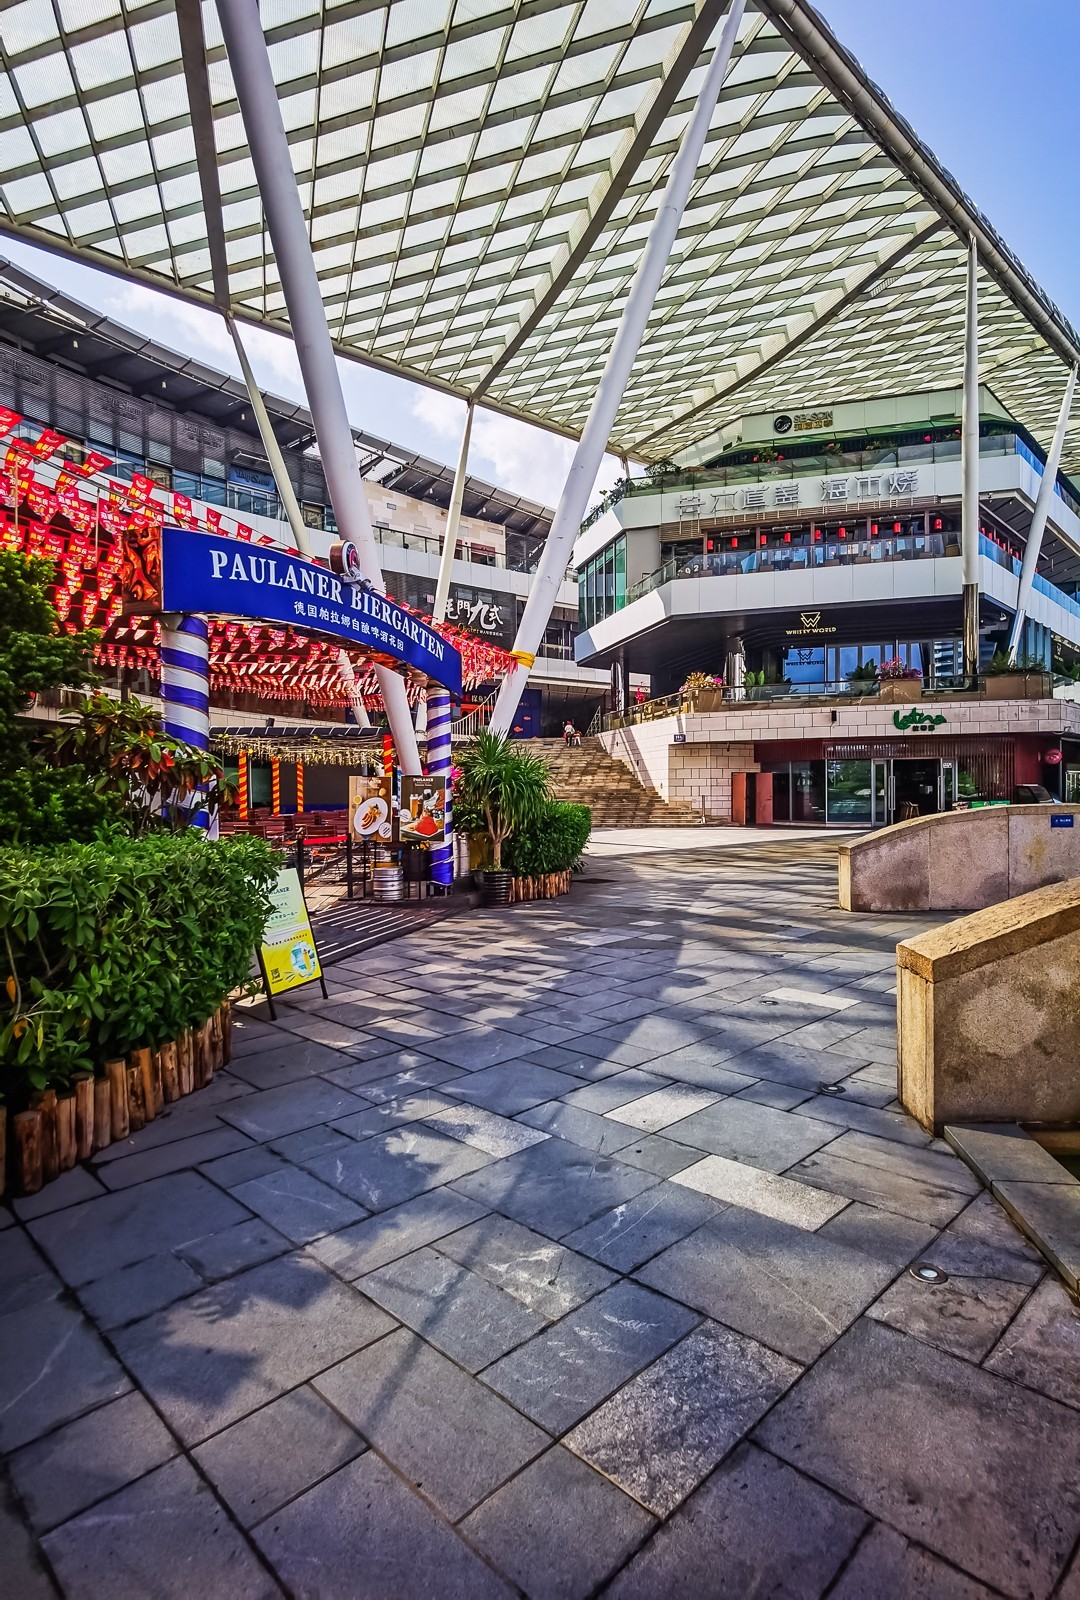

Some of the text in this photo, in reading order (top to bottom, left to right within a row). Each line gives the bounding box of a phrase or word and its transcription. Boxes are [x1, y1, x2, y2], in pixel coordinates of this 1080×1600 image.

[209, 549, 445, 662] PAULANER BIERGARTEN
[811, 626, 837, 634] WORLD
